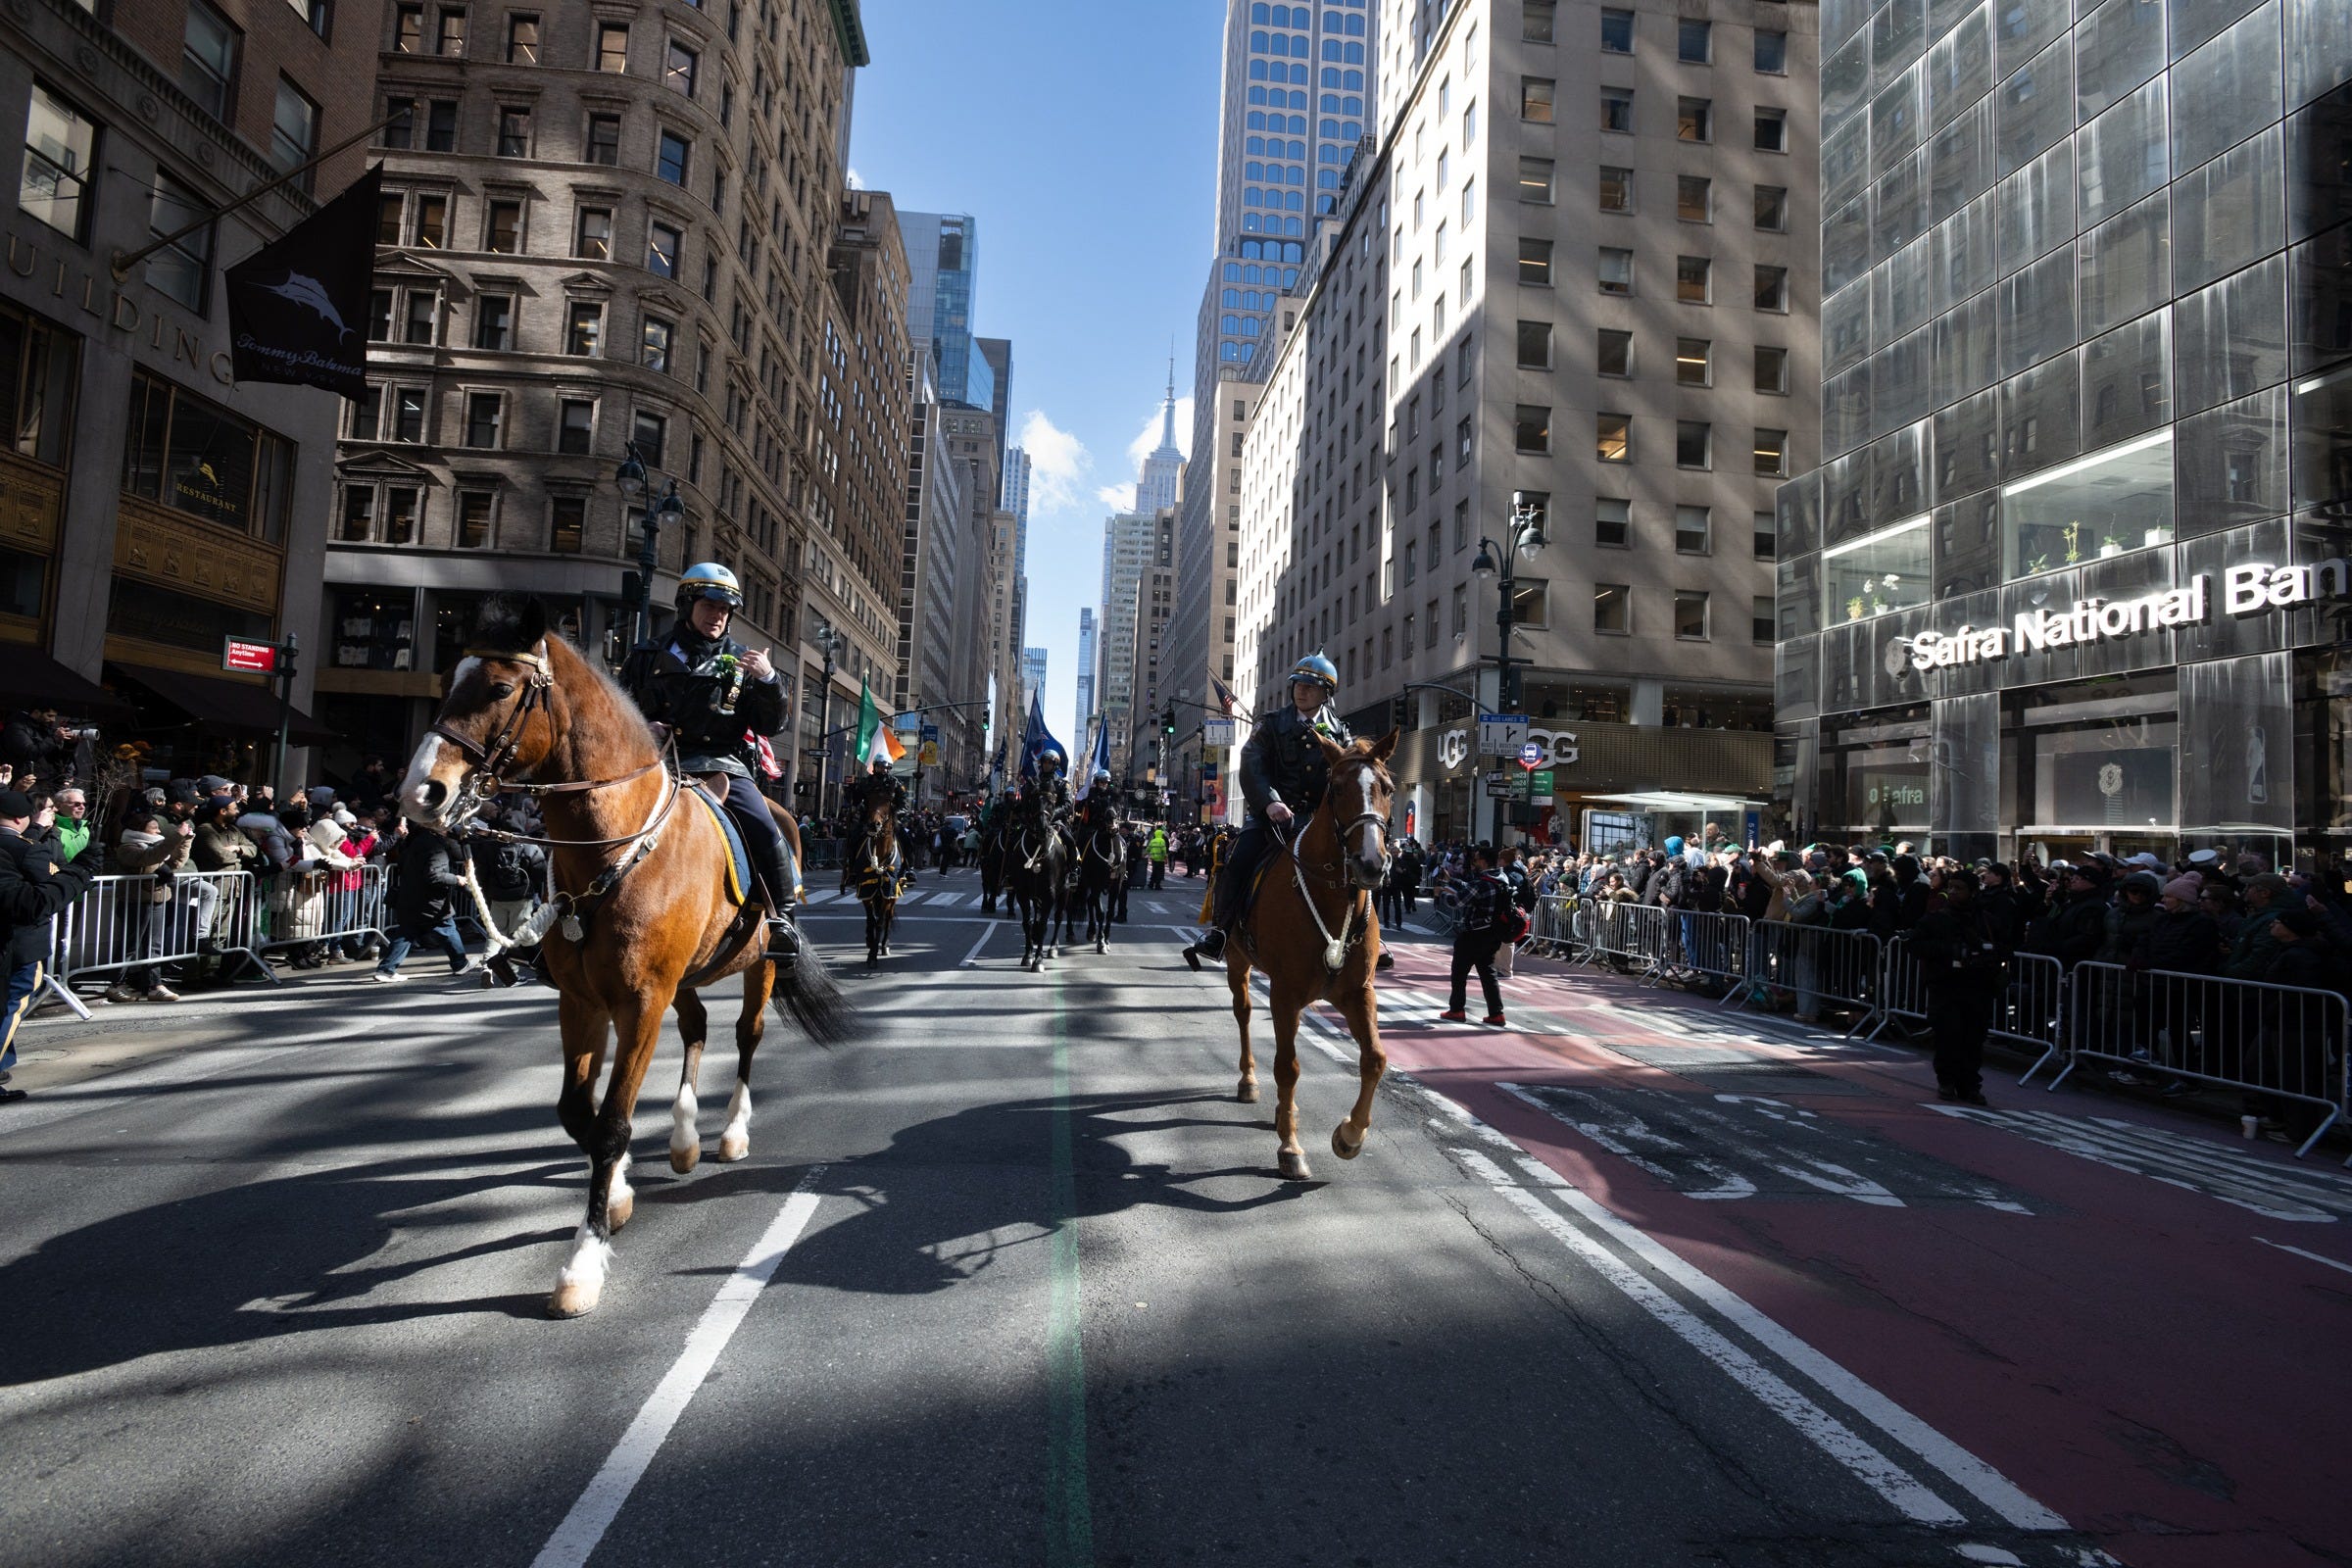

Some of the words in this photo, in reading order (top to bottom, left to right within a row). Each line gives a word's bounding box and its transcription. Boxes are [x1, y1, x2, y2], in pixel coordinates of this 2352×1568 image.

[235, 332, 300, 367] Tommy
[175, 482, 236, 513] RESTAURANT
[1911, 627, 2005, 670] Safra
[2014, 572, 2204, 653] National
[231, 649, 256, 658] Anytime
[241, 644, 270, 654] STANDING
[1437, 729, 1468, 769] UGG
[1506, 728, 1580, 770] GG
